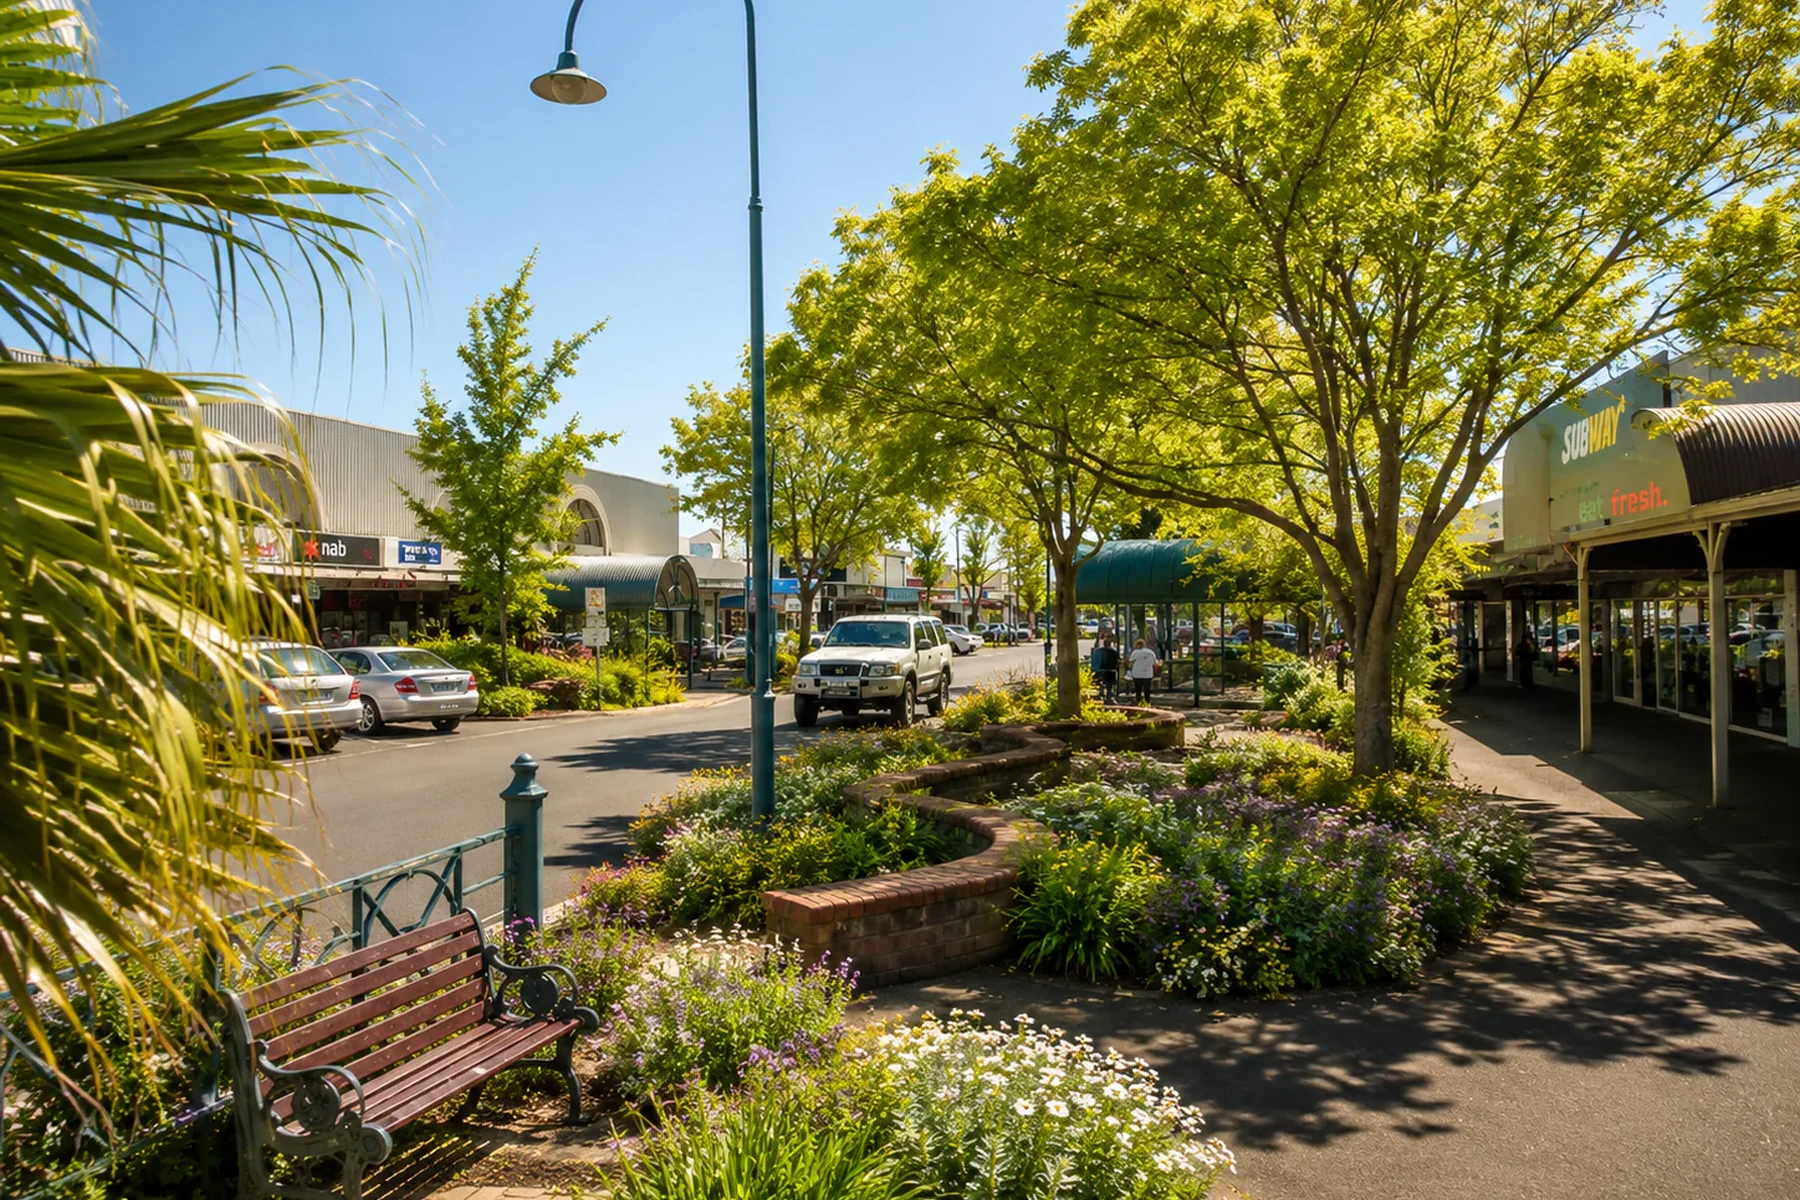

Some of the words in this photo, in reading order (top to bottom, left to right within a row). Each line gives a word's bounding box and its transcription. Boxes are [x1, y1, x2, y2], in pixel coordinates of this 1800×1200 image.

[1561, 394, 1625, 465] SUBWAY
[1611, 481, 1668, 516] fresh.
[321, 540, 347, 557] nab
